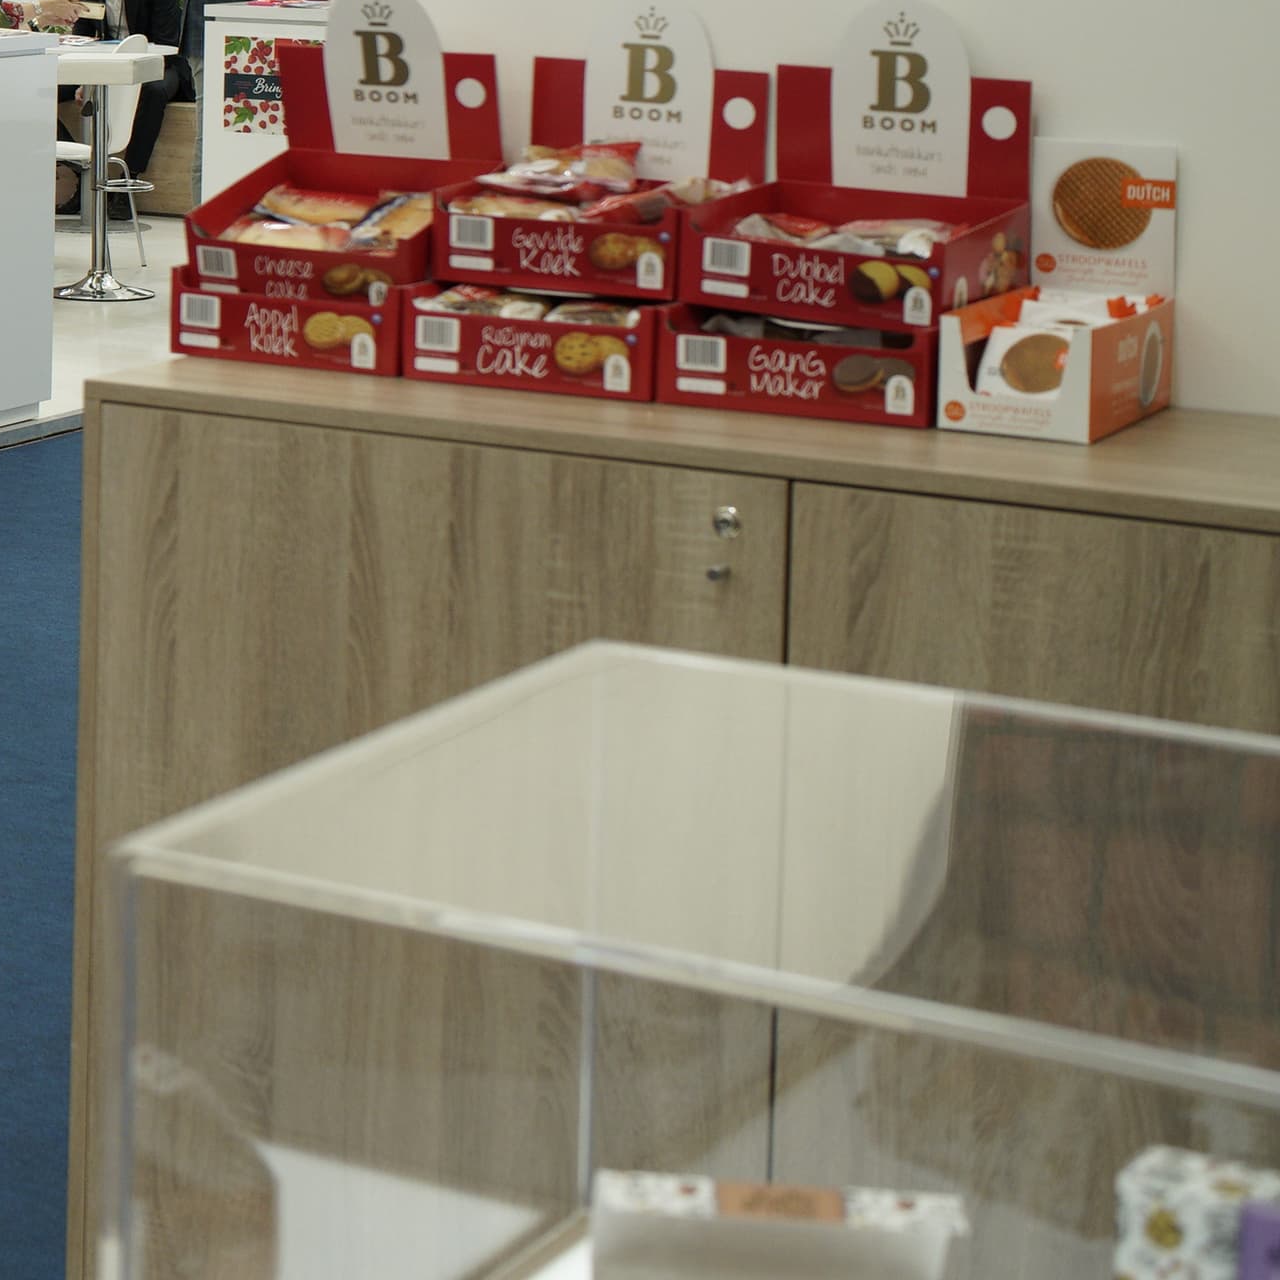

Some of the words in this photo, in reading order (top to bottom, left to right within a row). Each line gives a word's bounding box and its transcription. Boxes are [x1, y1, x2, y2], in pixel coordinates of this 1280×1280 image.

[353, 89, 418, 104] BOOM
[612, 105, 682, 123] BOOM
[863, 115, 937, 134] BOOM
[254, 255, 314, 279] Cheese
[775, 277, 836, 308] Cake
[476, 343, 550, 378] Cake
